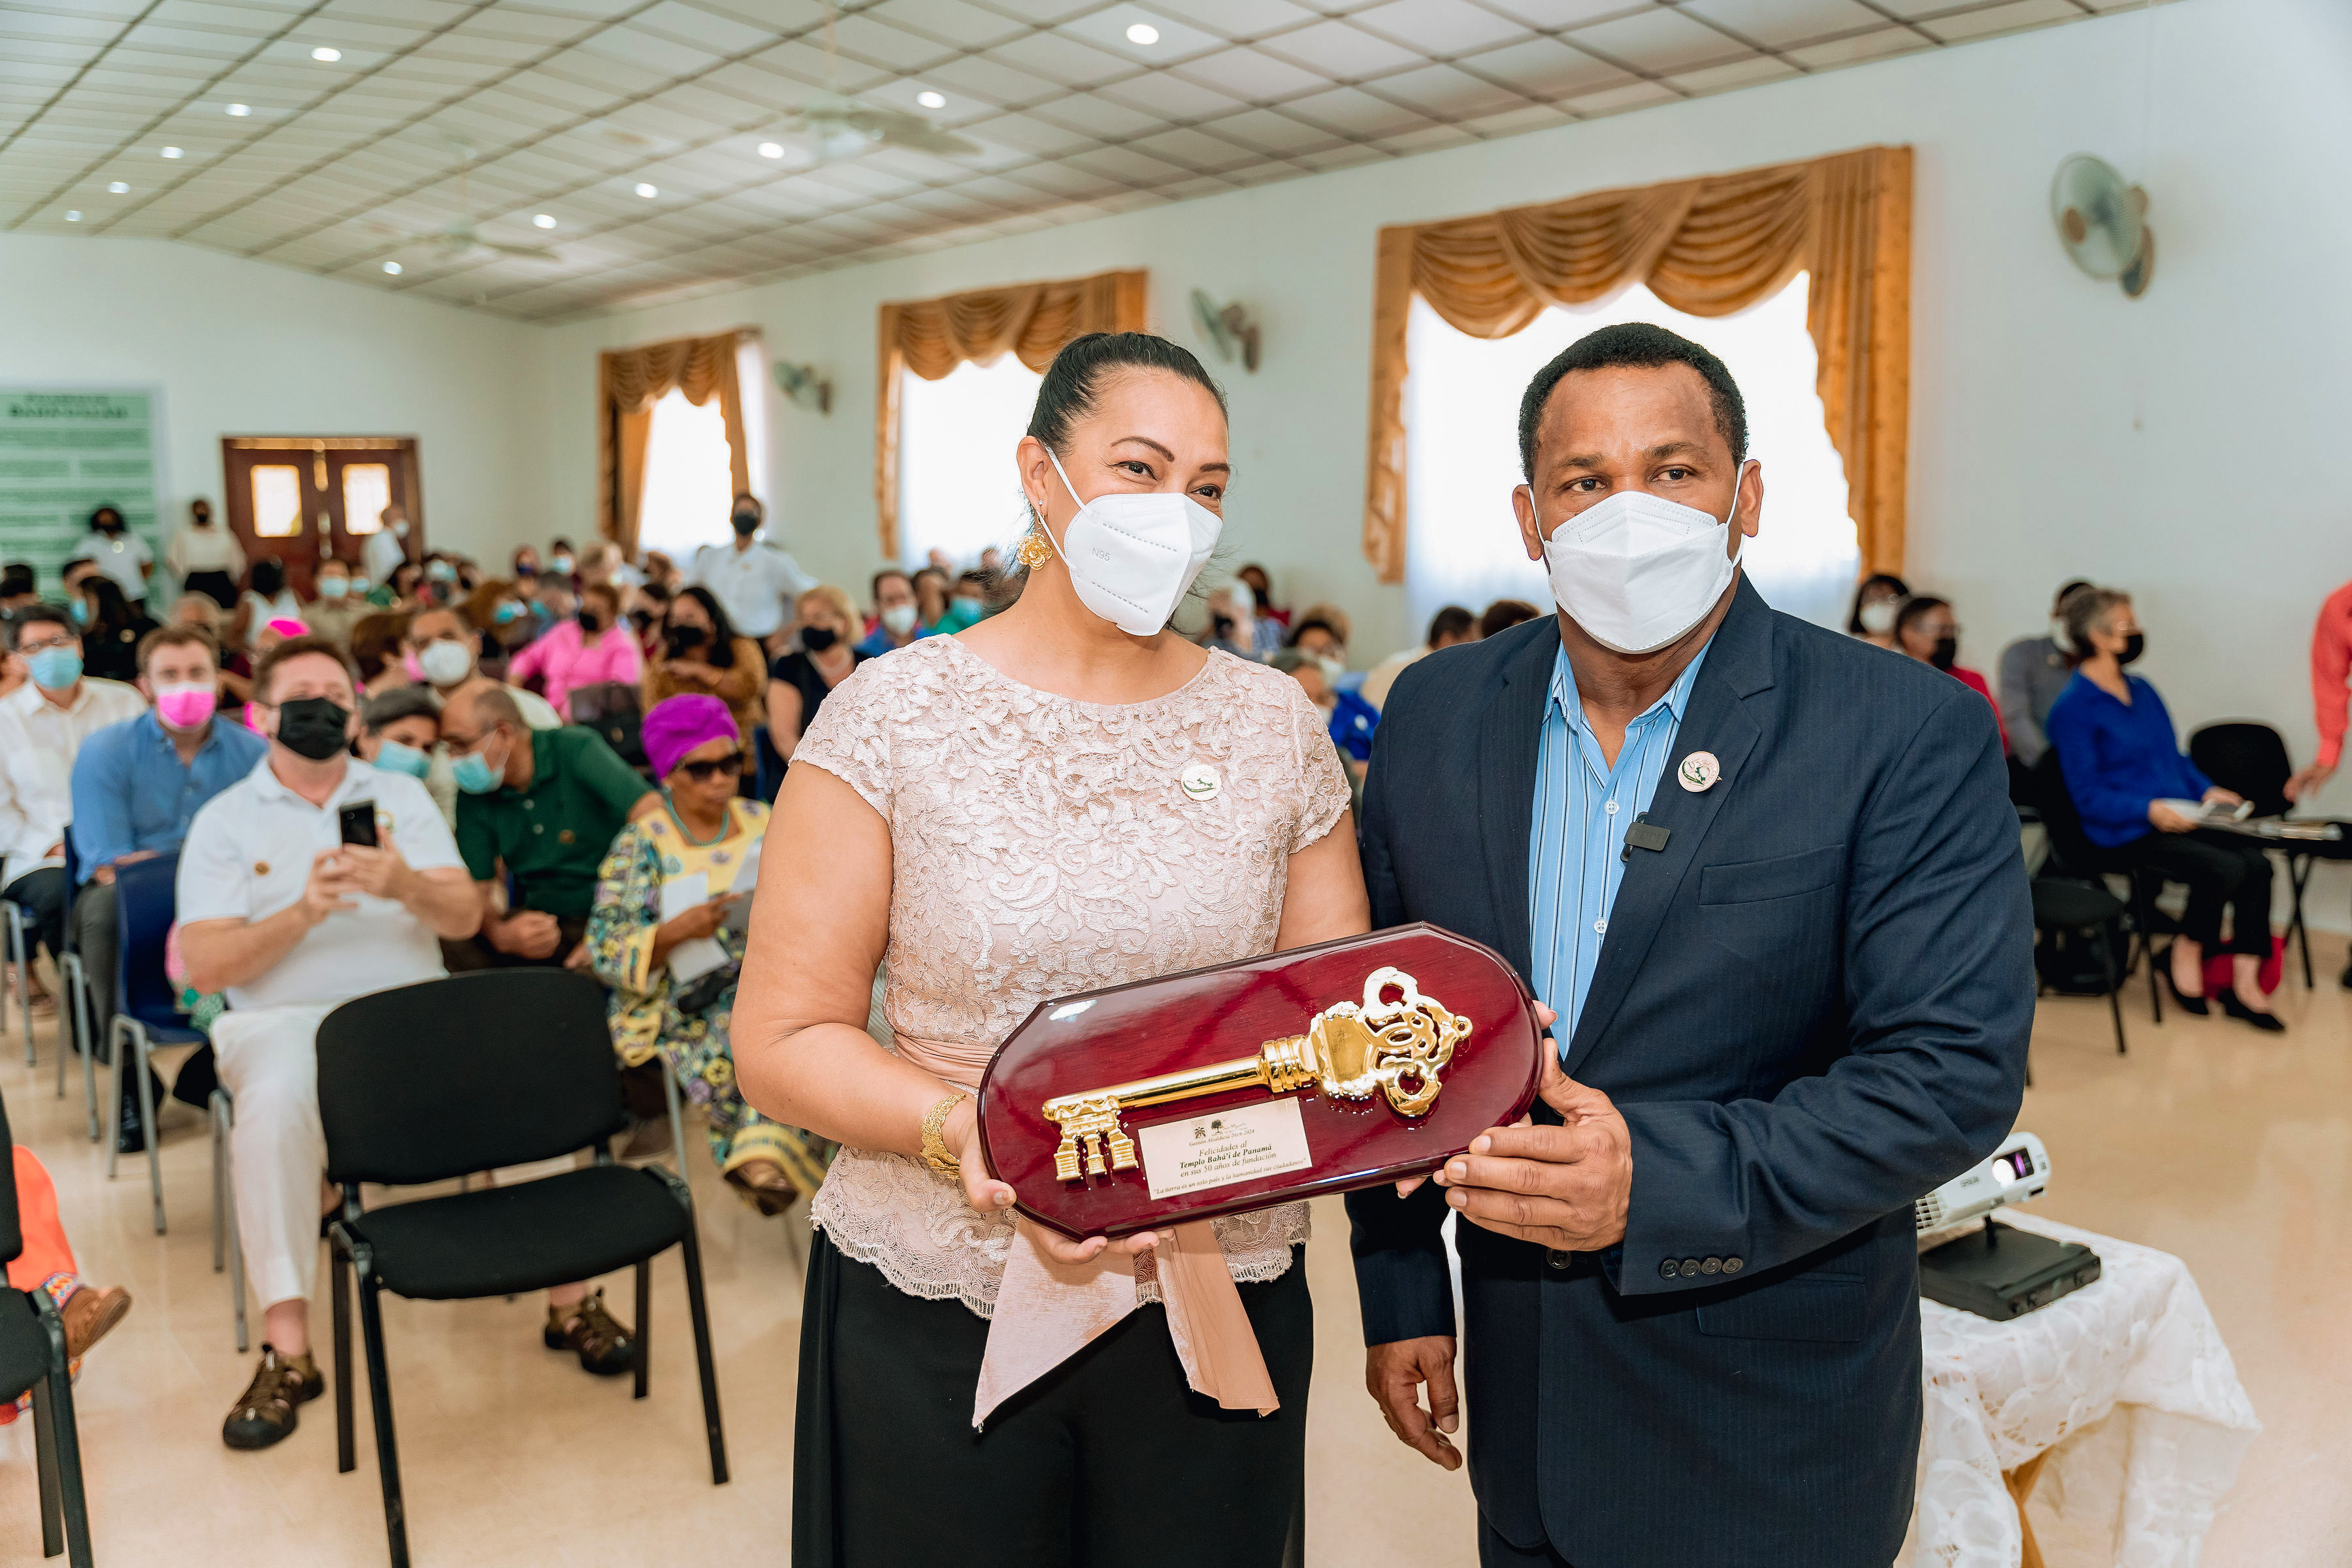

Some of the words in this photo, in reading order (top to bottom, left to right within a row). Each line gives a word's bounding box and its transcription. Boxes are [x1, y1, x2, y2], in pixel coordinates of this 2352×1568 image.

[1092, 547, 1110, 561] N95
[1180, 1158, 1205, 1169] Templo
[1243, 1143, 1272, 1156] Panamá
[1199, 1143, 1239, 1157] Felicidades
[1240, 1140, 1247, 1149] al
[1241, 1152, 1277, 1166] fundación
[1209, 1175, 1220, 1184] país
[1232, 1166, 1262, 1178] humanidad
